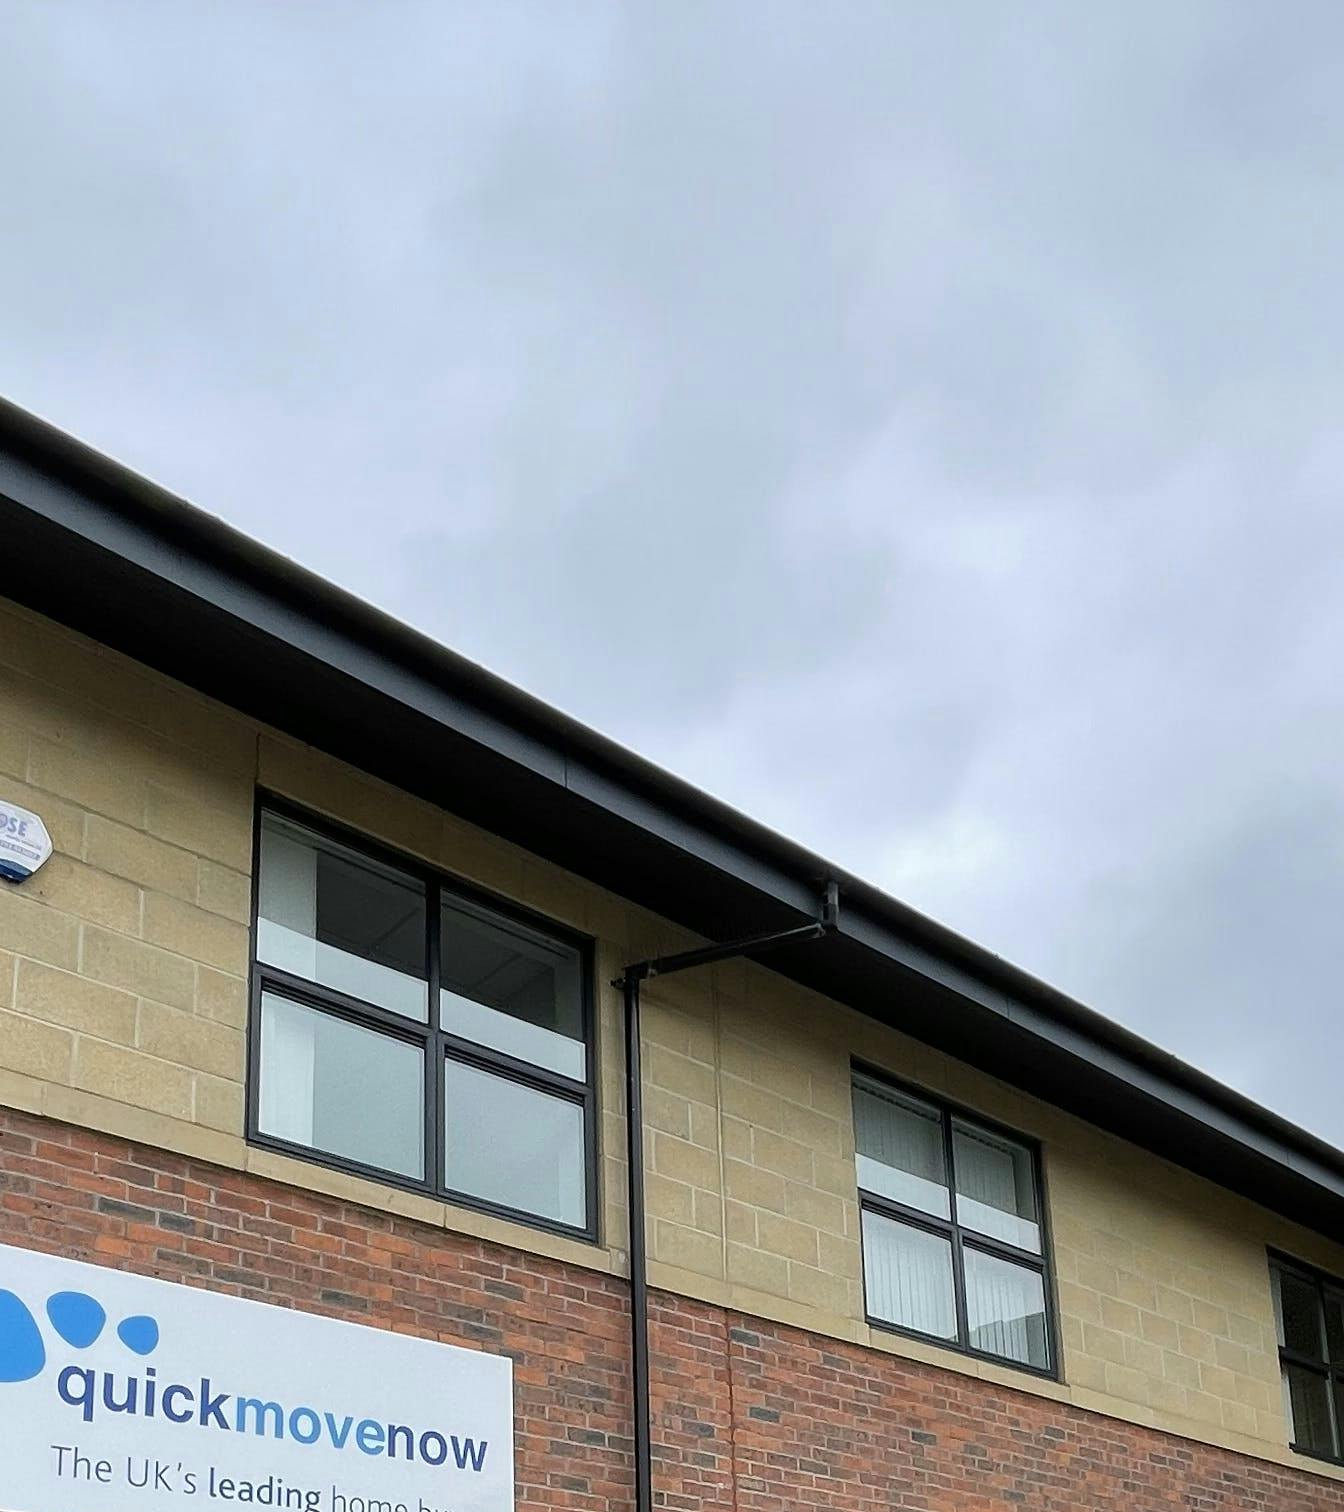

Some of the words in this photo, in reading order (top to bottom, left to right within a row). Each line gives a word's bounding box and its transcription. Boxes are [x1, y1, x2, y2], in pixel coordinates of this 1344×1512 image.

[57, 1364, 488, 1472] quickmovenow
[50, 1445, 112, 1482] The
[127, 1456, 197, 1494] UK's
